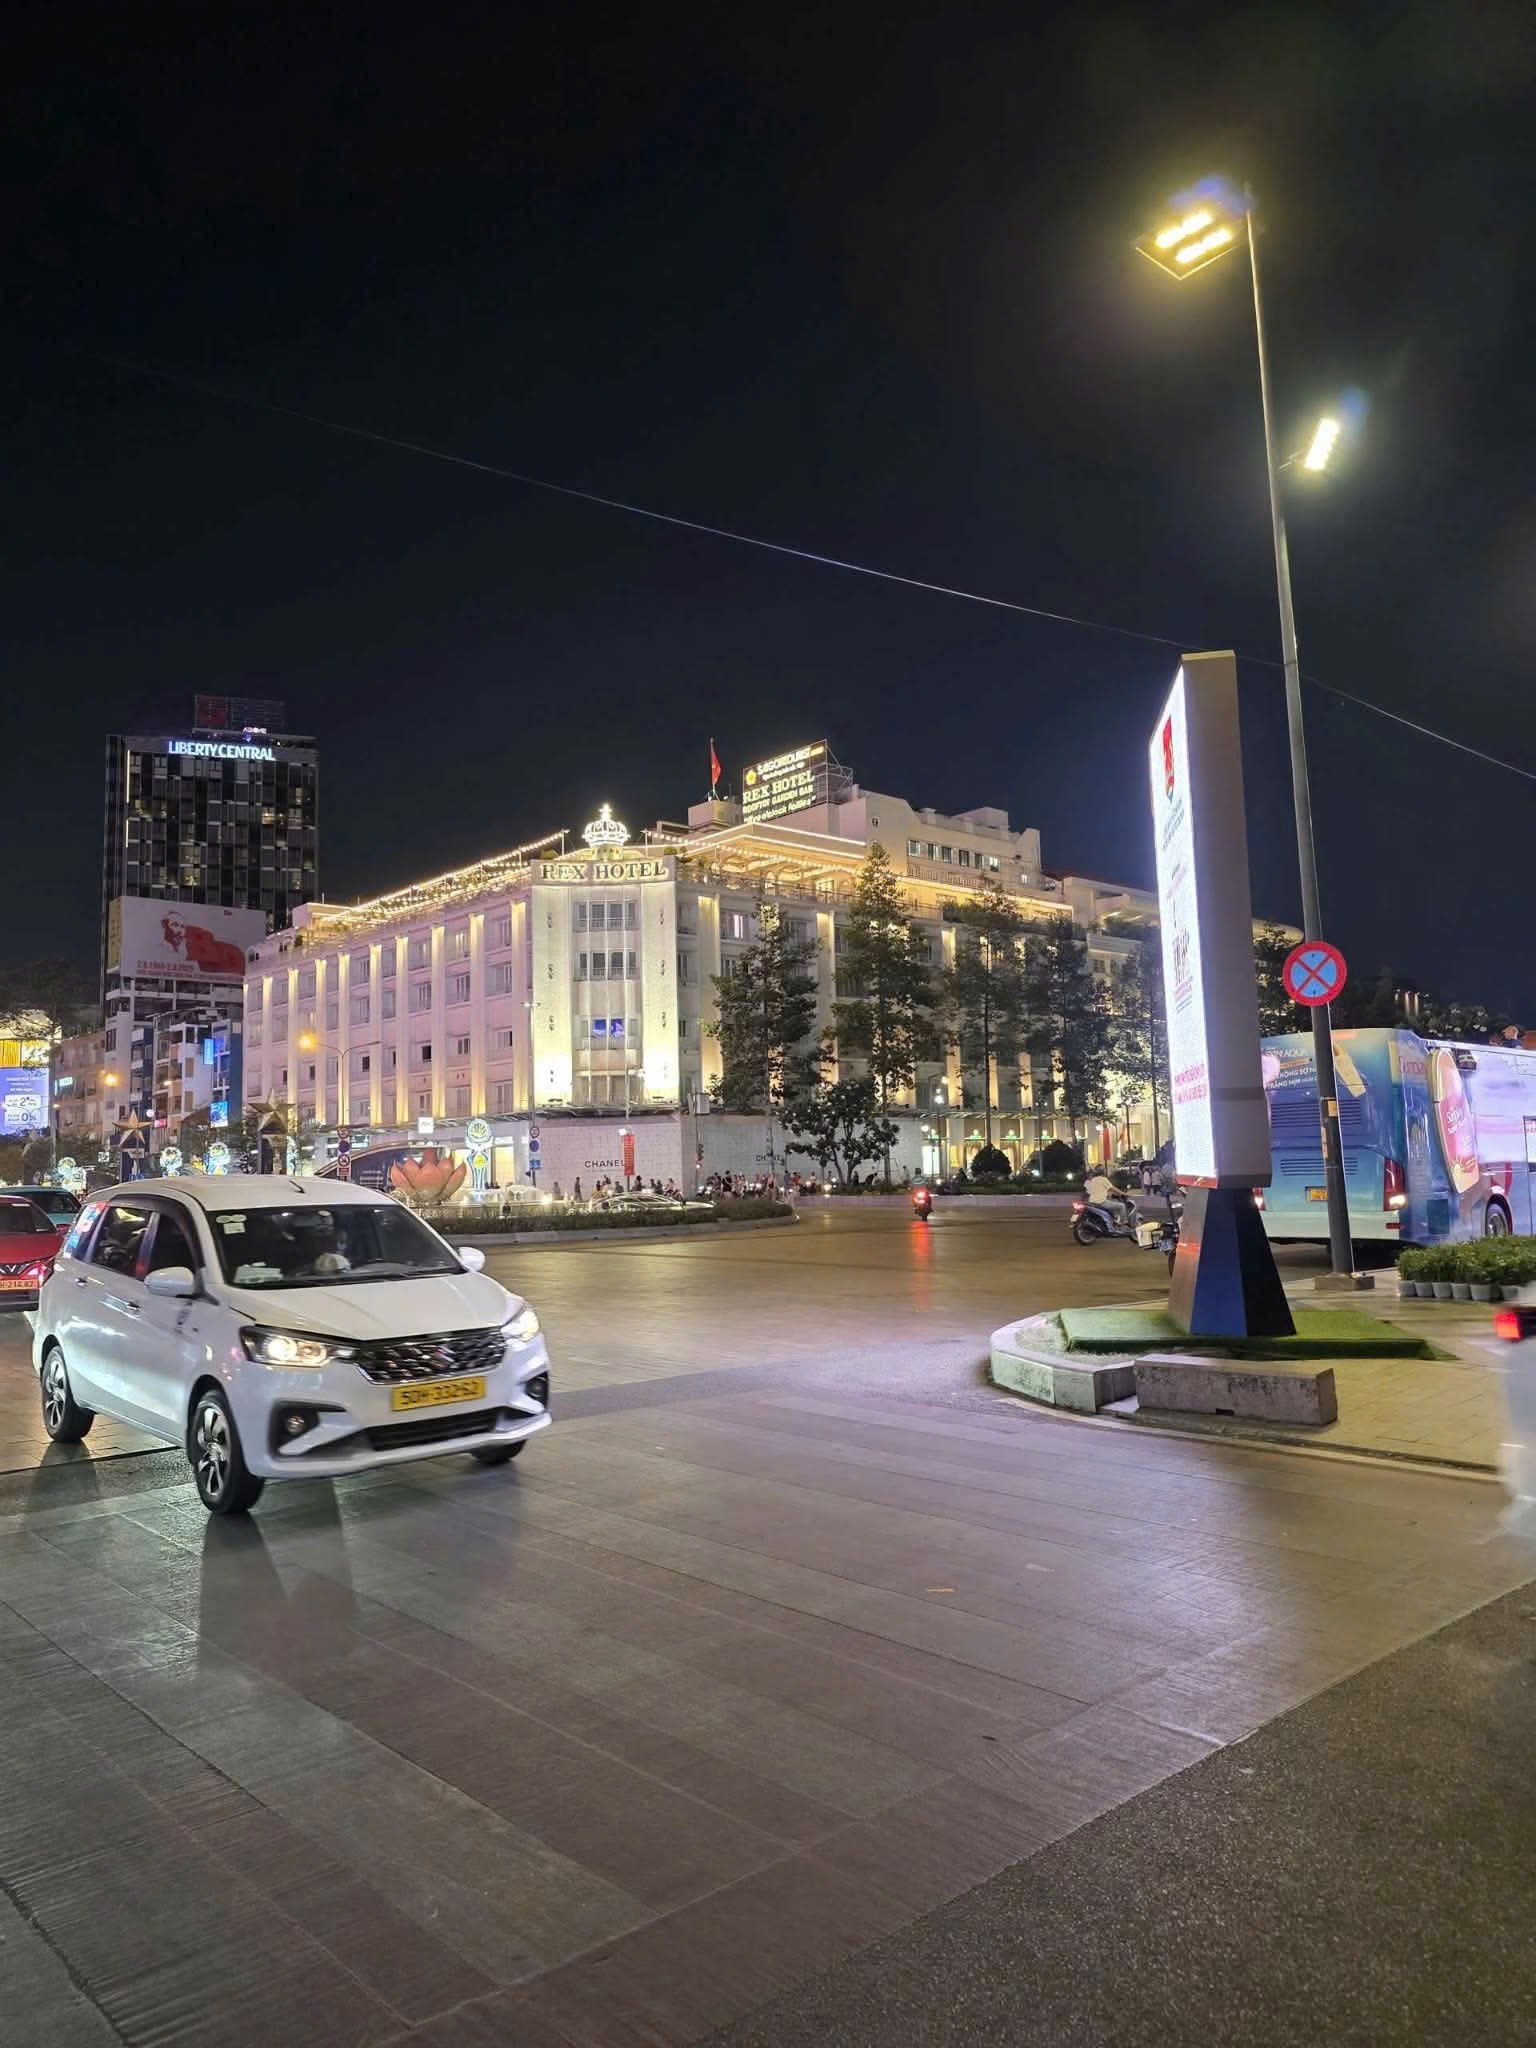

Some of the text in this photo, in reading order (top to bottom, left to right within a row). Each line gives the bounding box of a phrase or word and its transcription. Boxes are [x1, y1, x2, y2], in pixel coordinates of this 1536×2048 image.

[743, 784, 770, 805] REX
[771, 770, 815, 794] HOTEL
[541, 860, 667, 880] REX HOTEL
